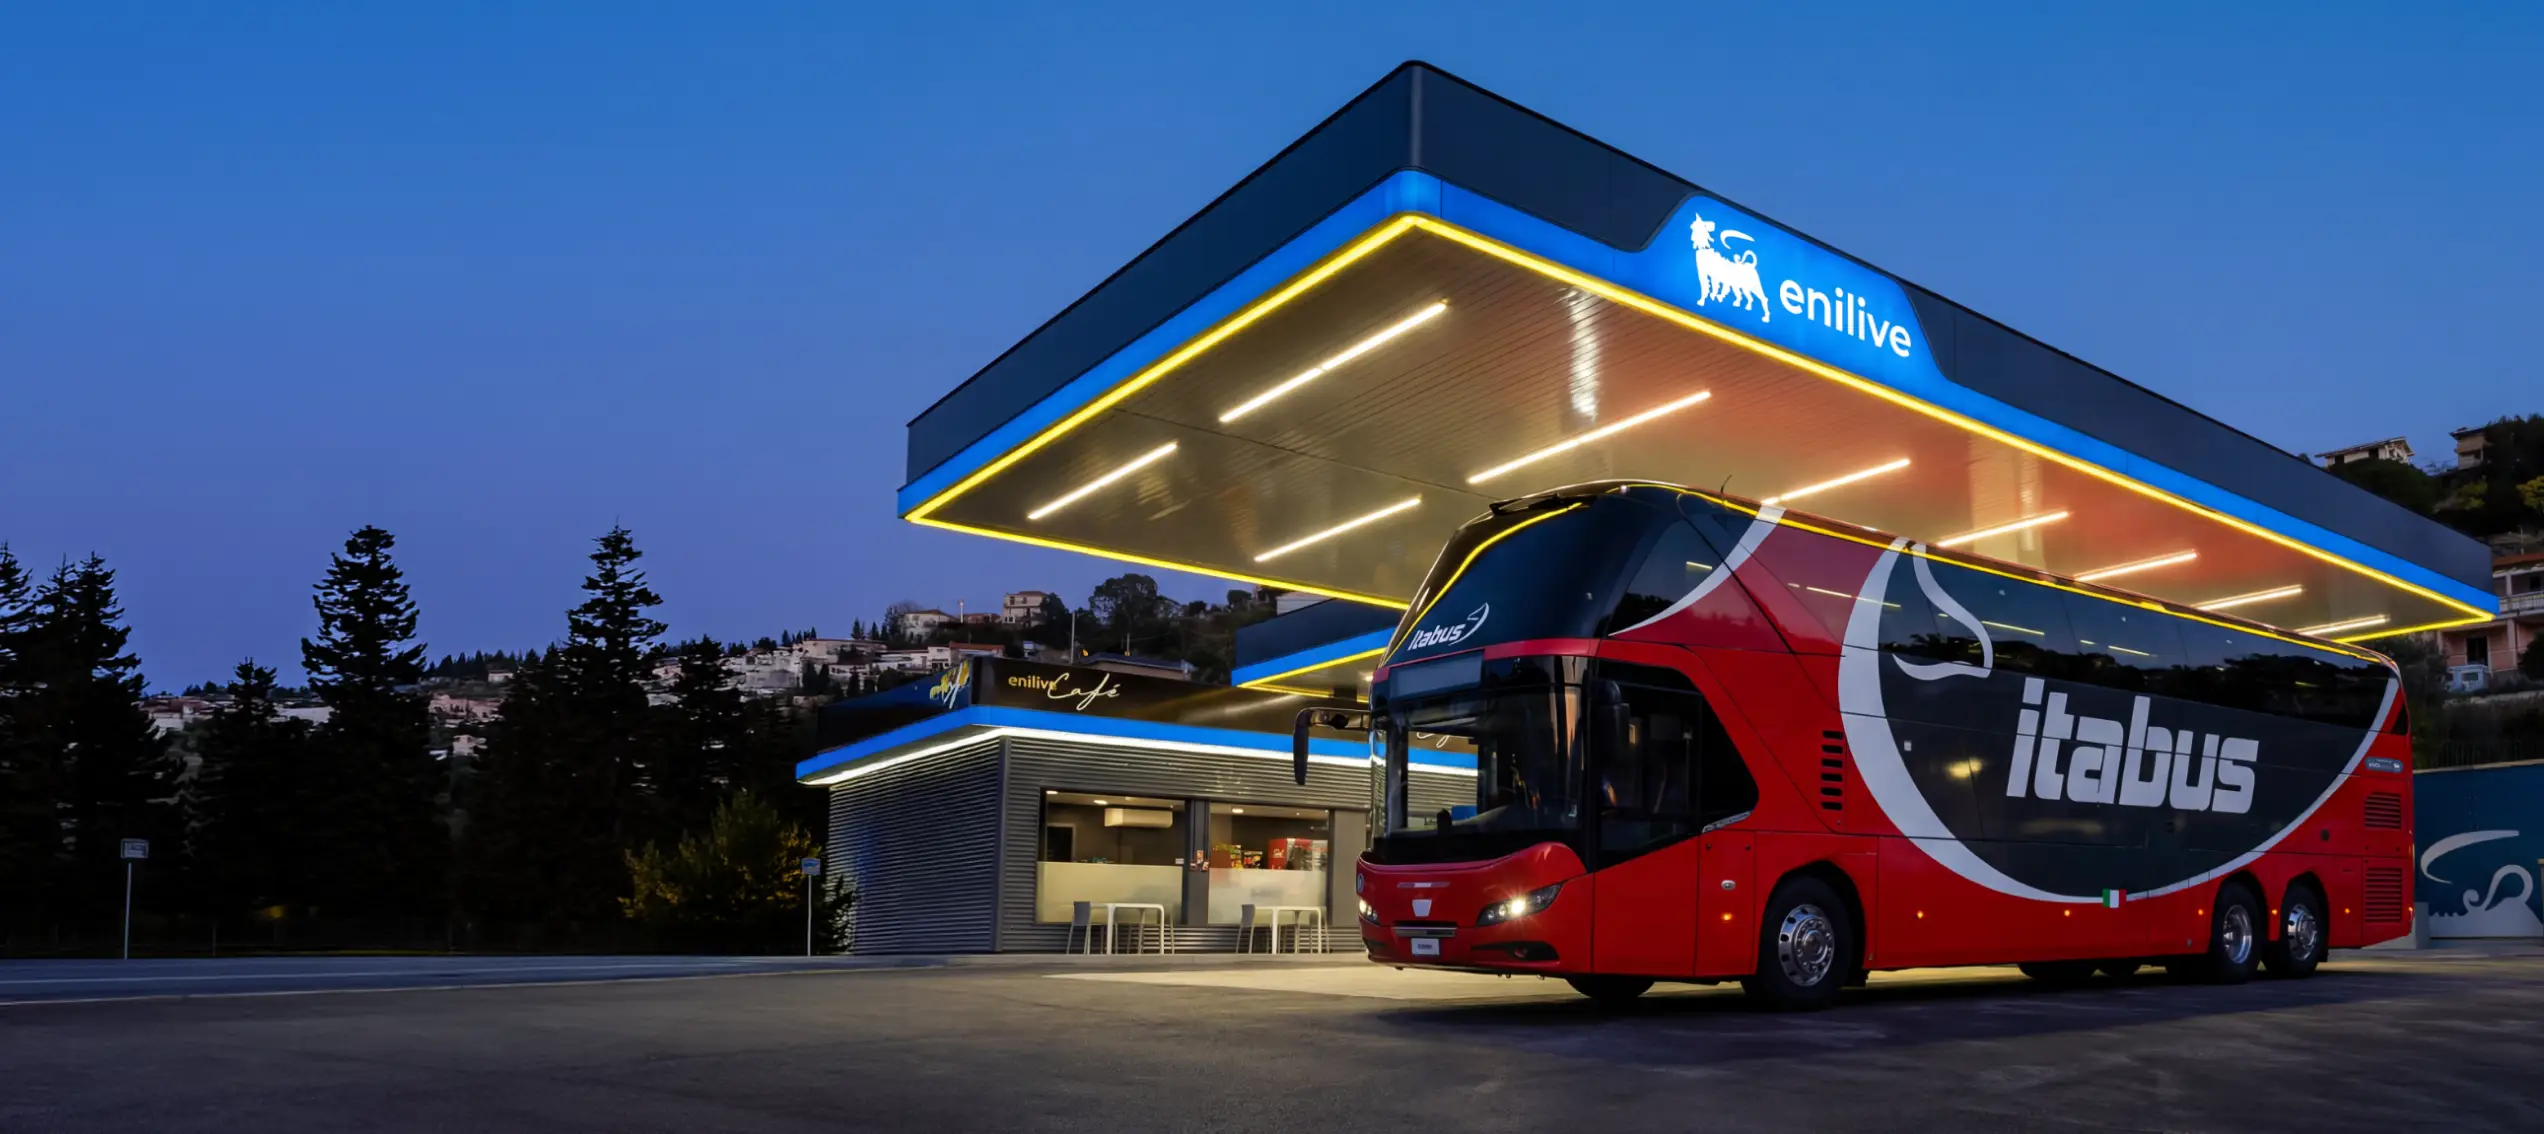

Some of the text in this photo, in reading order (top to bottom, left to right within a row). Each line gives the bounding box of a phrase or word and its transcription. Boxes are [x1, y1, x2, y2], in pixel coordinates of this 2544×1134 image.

[1779, 279, 1912, 358] enilive
[1048, 672, 1121, 710] Café
[2006, 677, 2259, 814] itabus
